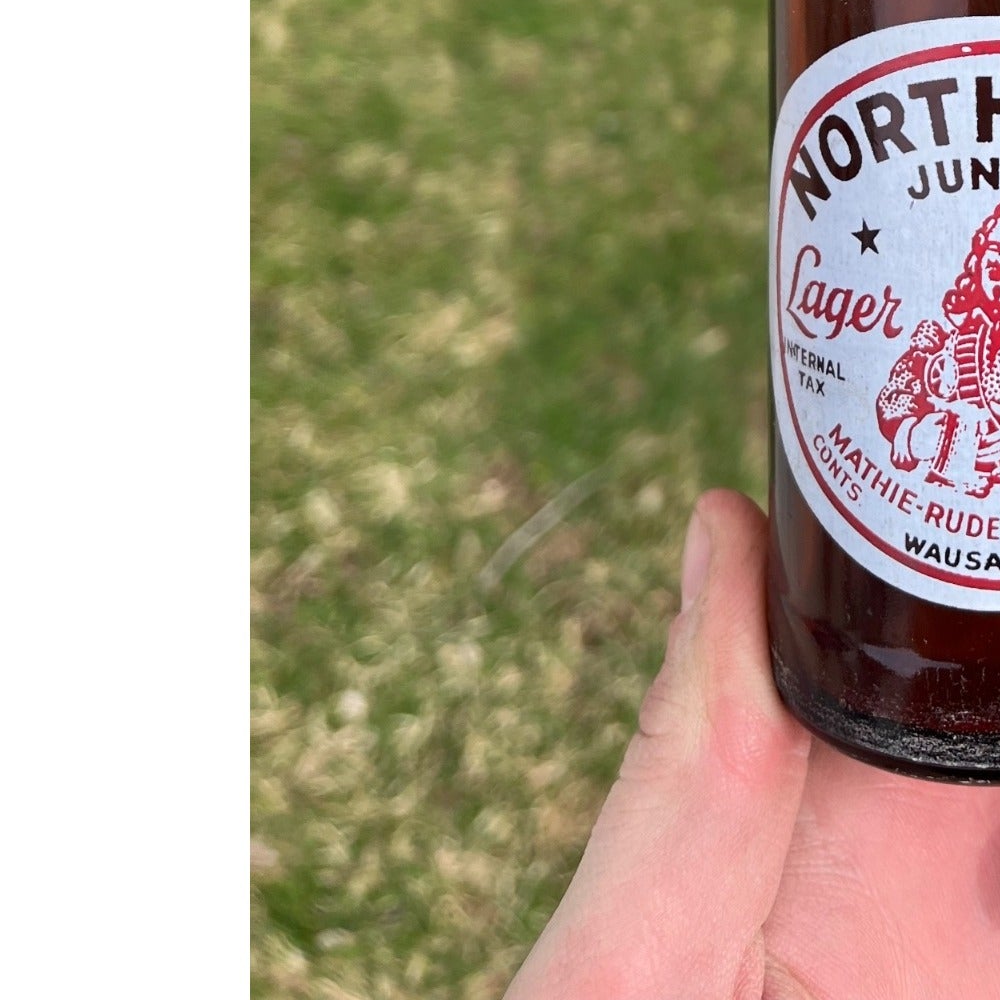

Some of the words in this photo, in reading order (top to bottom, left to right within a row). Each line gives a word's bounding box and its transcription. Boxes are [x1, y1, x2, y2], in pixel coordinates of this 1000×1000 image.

[786, 244, 903, 339] Lager
[783, 336, 846, 382] INTERNAL
[798, 371, 826, 397] TAX
